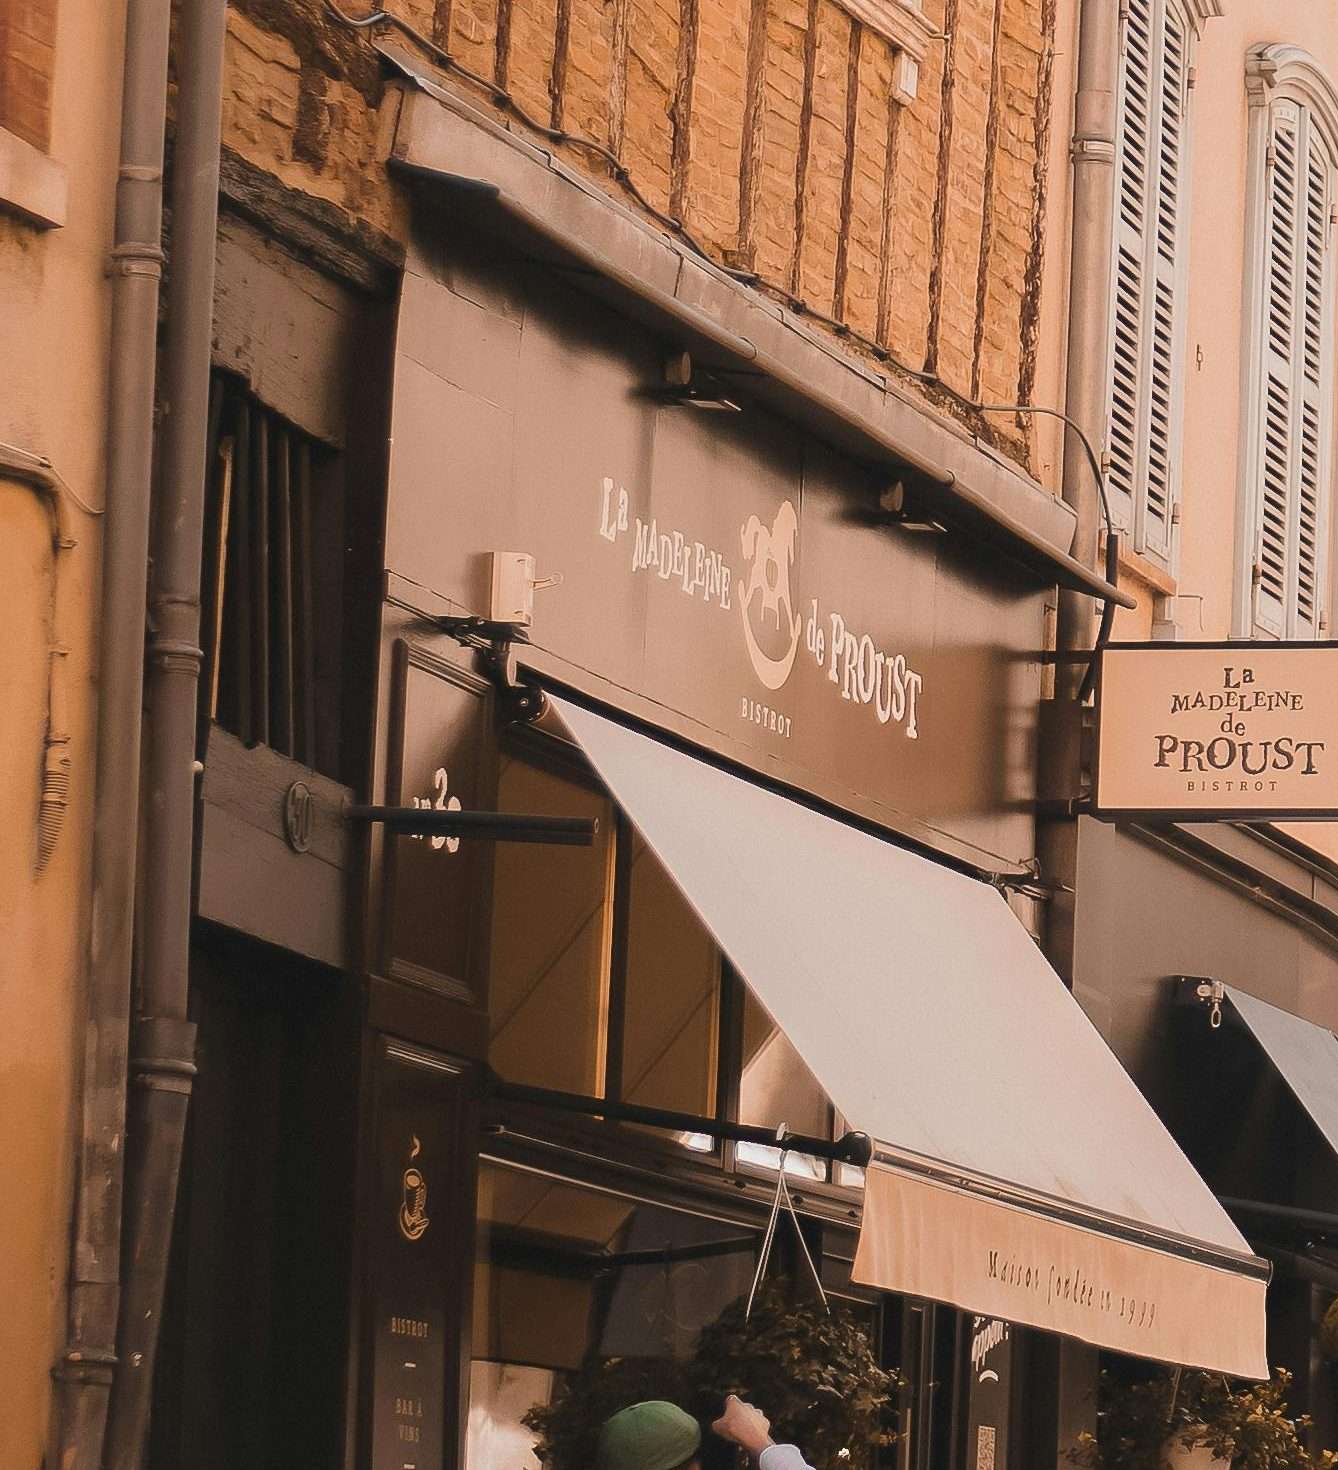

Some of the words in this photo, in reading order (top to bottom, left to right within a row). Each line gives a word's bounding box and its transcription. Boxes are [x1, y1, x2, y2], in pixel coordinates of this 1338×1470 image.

[599, 477, 629, 542] La
[632, 517, 731, 610] MADELEINE
[806, 598, 825, 667] de
[829, 612, 922, 740] PROUST
[1223, 667, 1255, 689] La
[1171, 691, 1304, 714] MADELEINE
[741, 697, 792, 738] BISTROT
[1220, 713, 1245, 736] de
[1153, 735, 1325, 775] PROUST
[1187, 781, 1279, 792] BISTROT
[987, 1251, 1039, 1289] Maison
[391, 1317, 429, 1337] BISTROT
[400, 1424, 420, 1443] VINS
